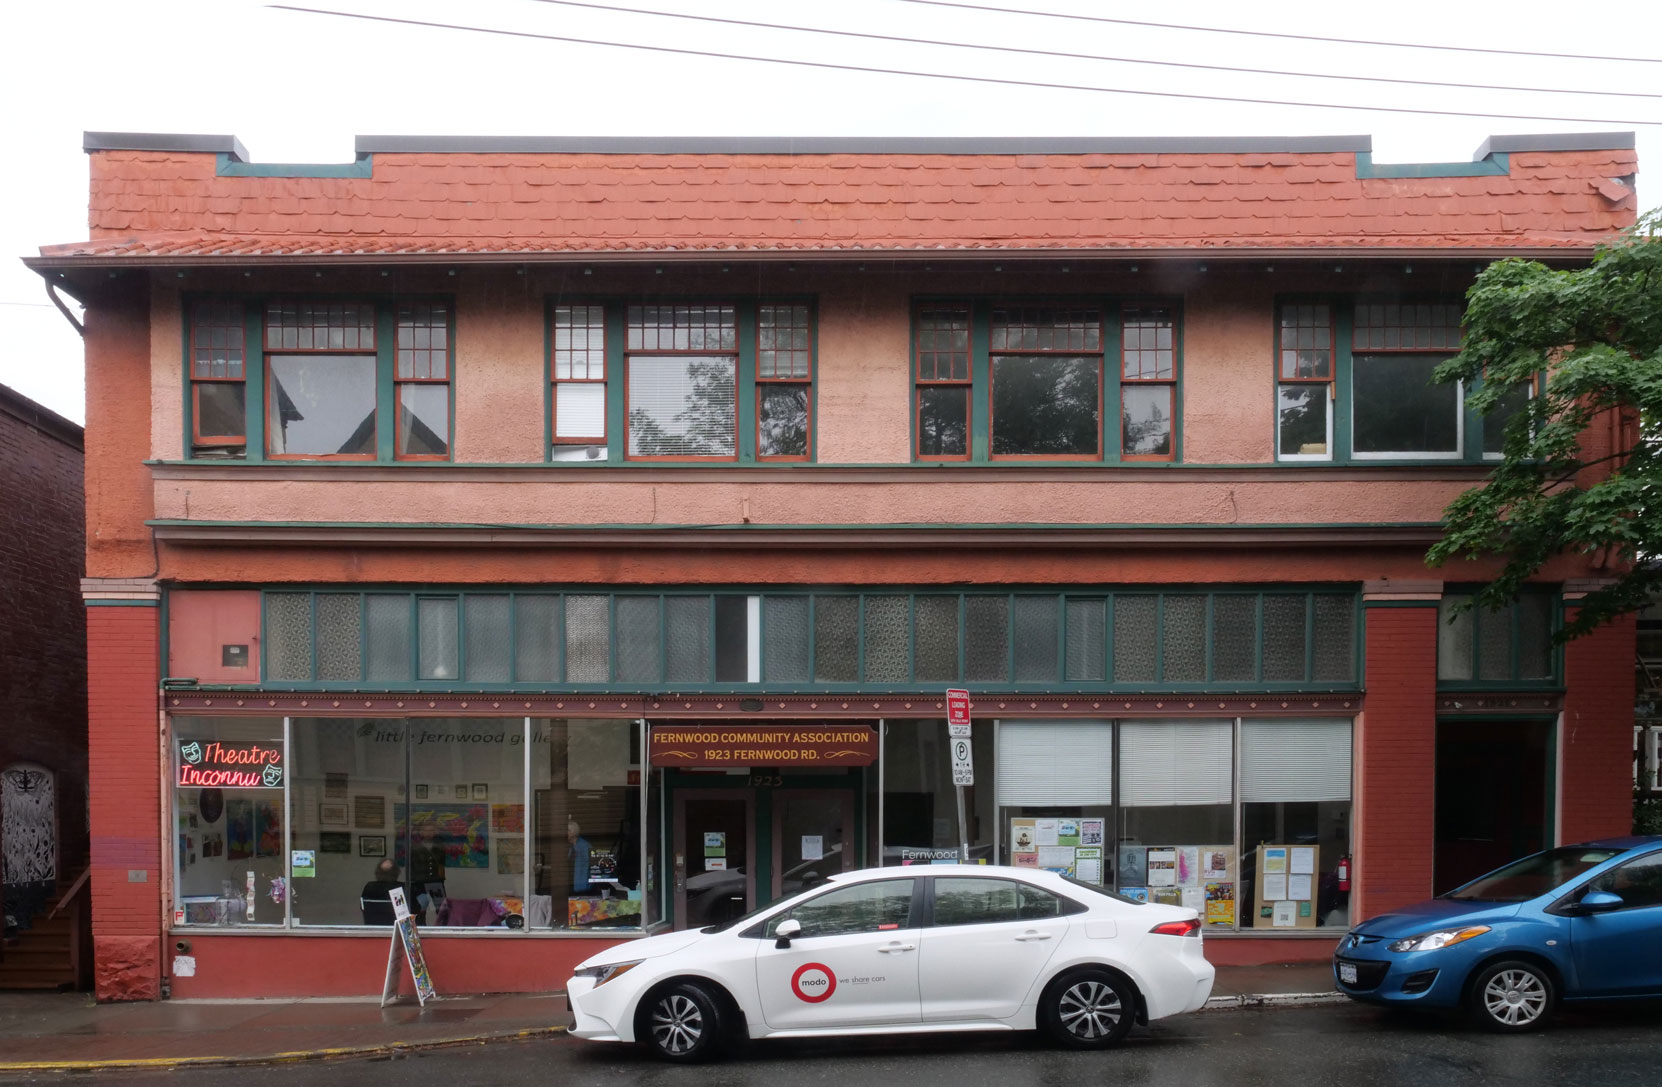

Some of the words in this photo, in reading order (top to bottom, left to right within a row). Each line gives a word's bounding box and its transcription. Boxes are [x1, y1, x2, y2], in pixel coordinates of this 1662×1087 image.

[418, 731, 505, 745] fernwood
[654, 733, 719, 743] FERNWOOD
[720, 733, 790, 743] COMMUNITY
[793, 732, 869, 743] ASSOCIATION
[205, 742, 280, 764] Theatre
[704, 750, 731, 760] 1923
[733, 750, 798, 760] FERNWOOD
[800, 750, 820, 760] RD.
[180, 765, 260, 786] Inconnu
[747, 775, 783, 787] 1923
[902, 849, 958, 860] Fernwood
[801, 978, 827, 986] modo
[851, 975, 870, 984] share
